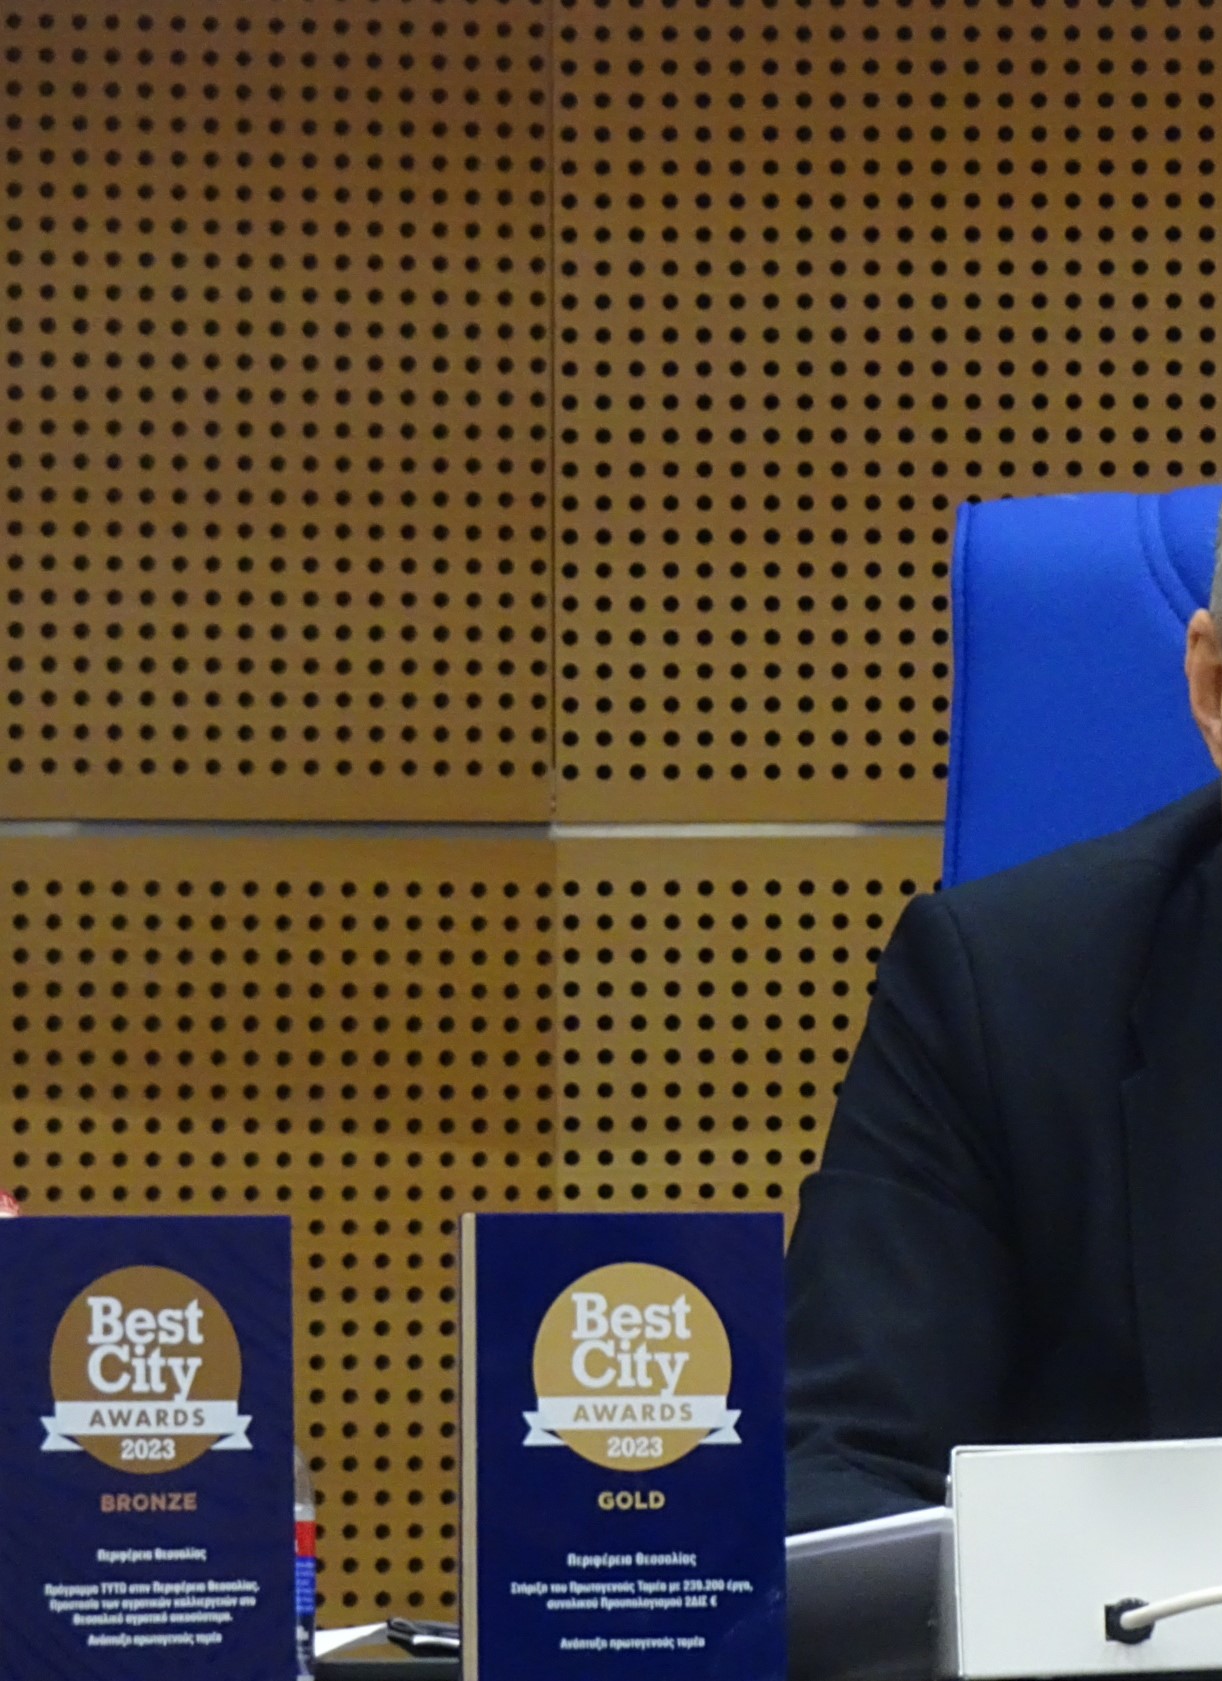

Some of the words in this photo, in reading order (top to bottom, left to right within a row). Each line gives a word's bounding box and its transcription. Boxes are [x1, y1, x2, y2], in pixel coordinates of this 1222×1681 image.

[86, 1296, 204, 1345] Best
[571, 1292, 690, 1341] Best
[87, 1344, 203, 1401] City
[571, 1339, 689, 1396] City
[89, 1407, 206, 1428] AWARDS
[573, 1402, 693, 1422] AWARDS
[120, 1437, 176, 1460] 2023
[607, 1435, 663, 1458] 2023
[100, 1492, 198, 1513] BRONZE
[597, 1491, 665, 1510] GOLD
[97, 1548, 152, 1563] Περιφέρεια
[154, 1547, 207, 1562] Θεσσαλίας
[567, 1552, 633, 1568] Περιφέρεια
[635, 1551, 697, 1567] Θεσσαλίας
